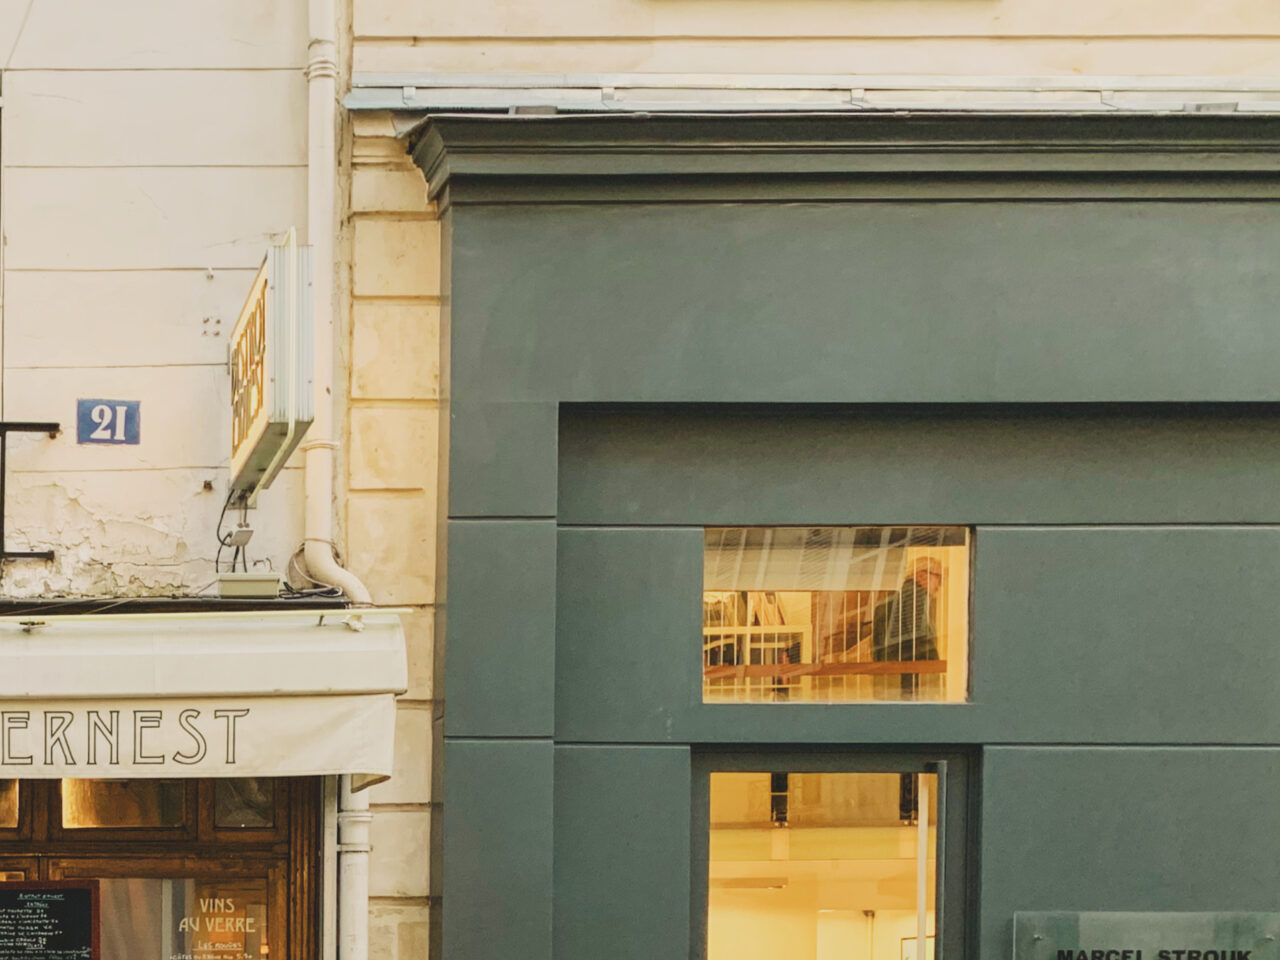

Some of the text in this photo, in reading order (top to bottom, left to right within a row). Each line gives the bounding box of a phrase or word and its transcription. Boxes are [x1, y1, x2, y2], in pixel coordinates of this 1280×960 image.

[89, 404, 128, 440] 21
[1, 708, 251, 766] ERNEST
[200, 898, 235, 913] VINS
[178, 917, 256, 933] AU VERRE
